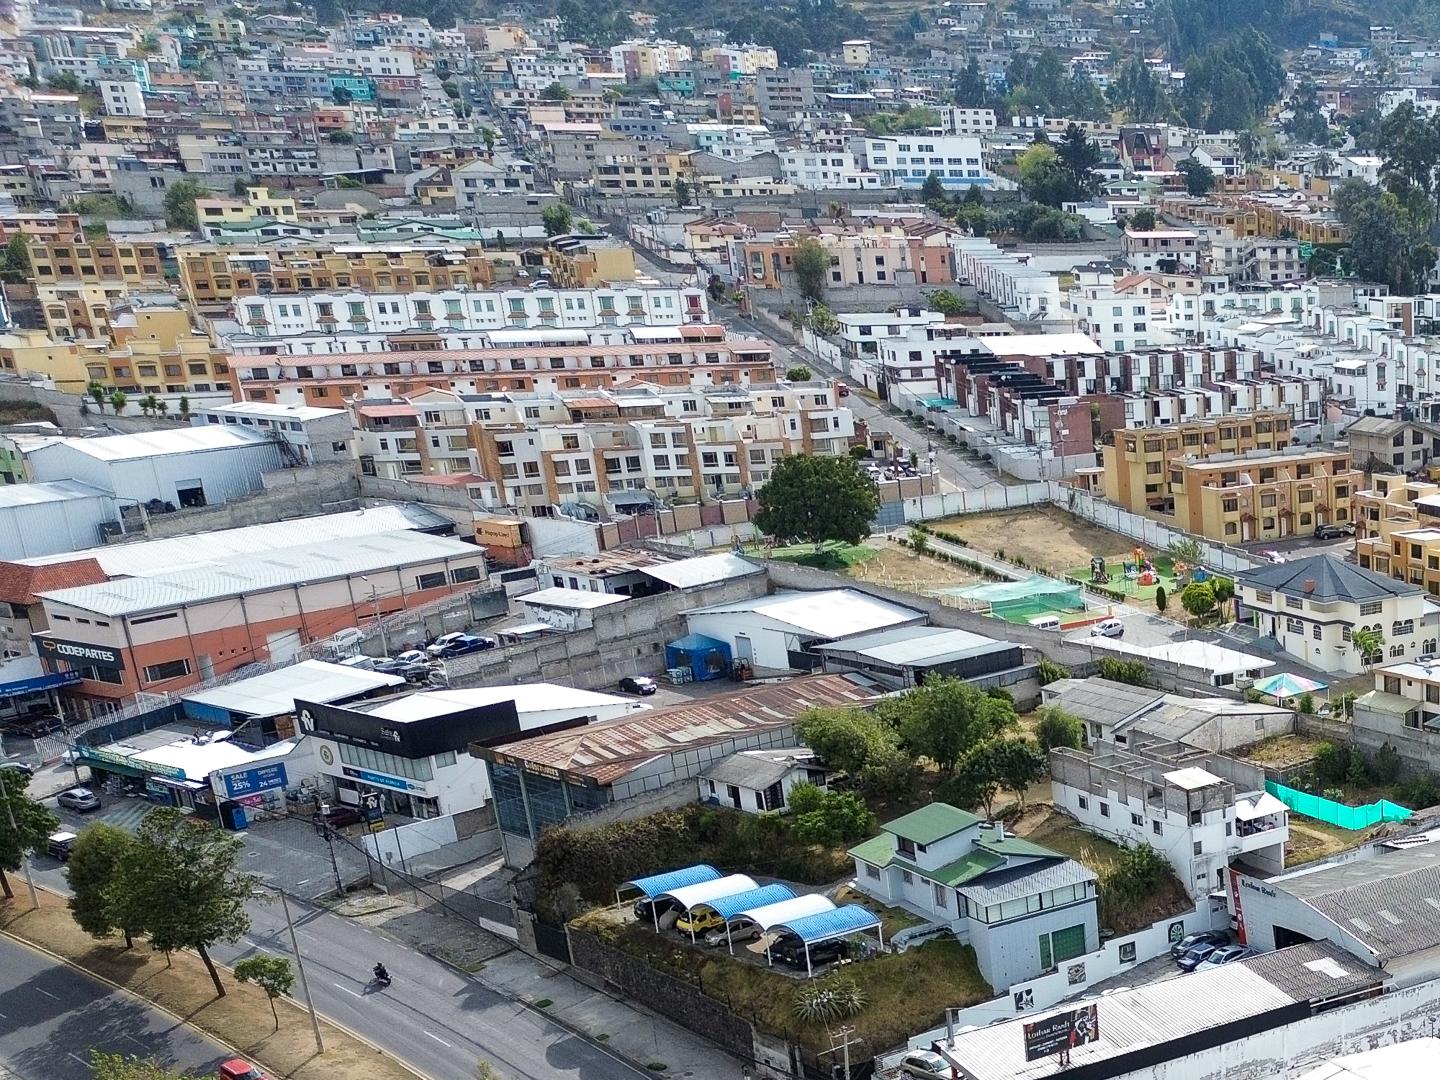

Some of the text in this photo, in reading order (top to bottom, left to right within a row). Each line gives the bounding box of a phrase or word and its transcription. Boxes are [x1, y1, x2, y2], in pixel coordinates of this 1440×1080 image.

[57, 644, 115, 662] CODEPARTES
[230, 772, 248, 781] SALE
[232, 781, 251, 791] 25%
